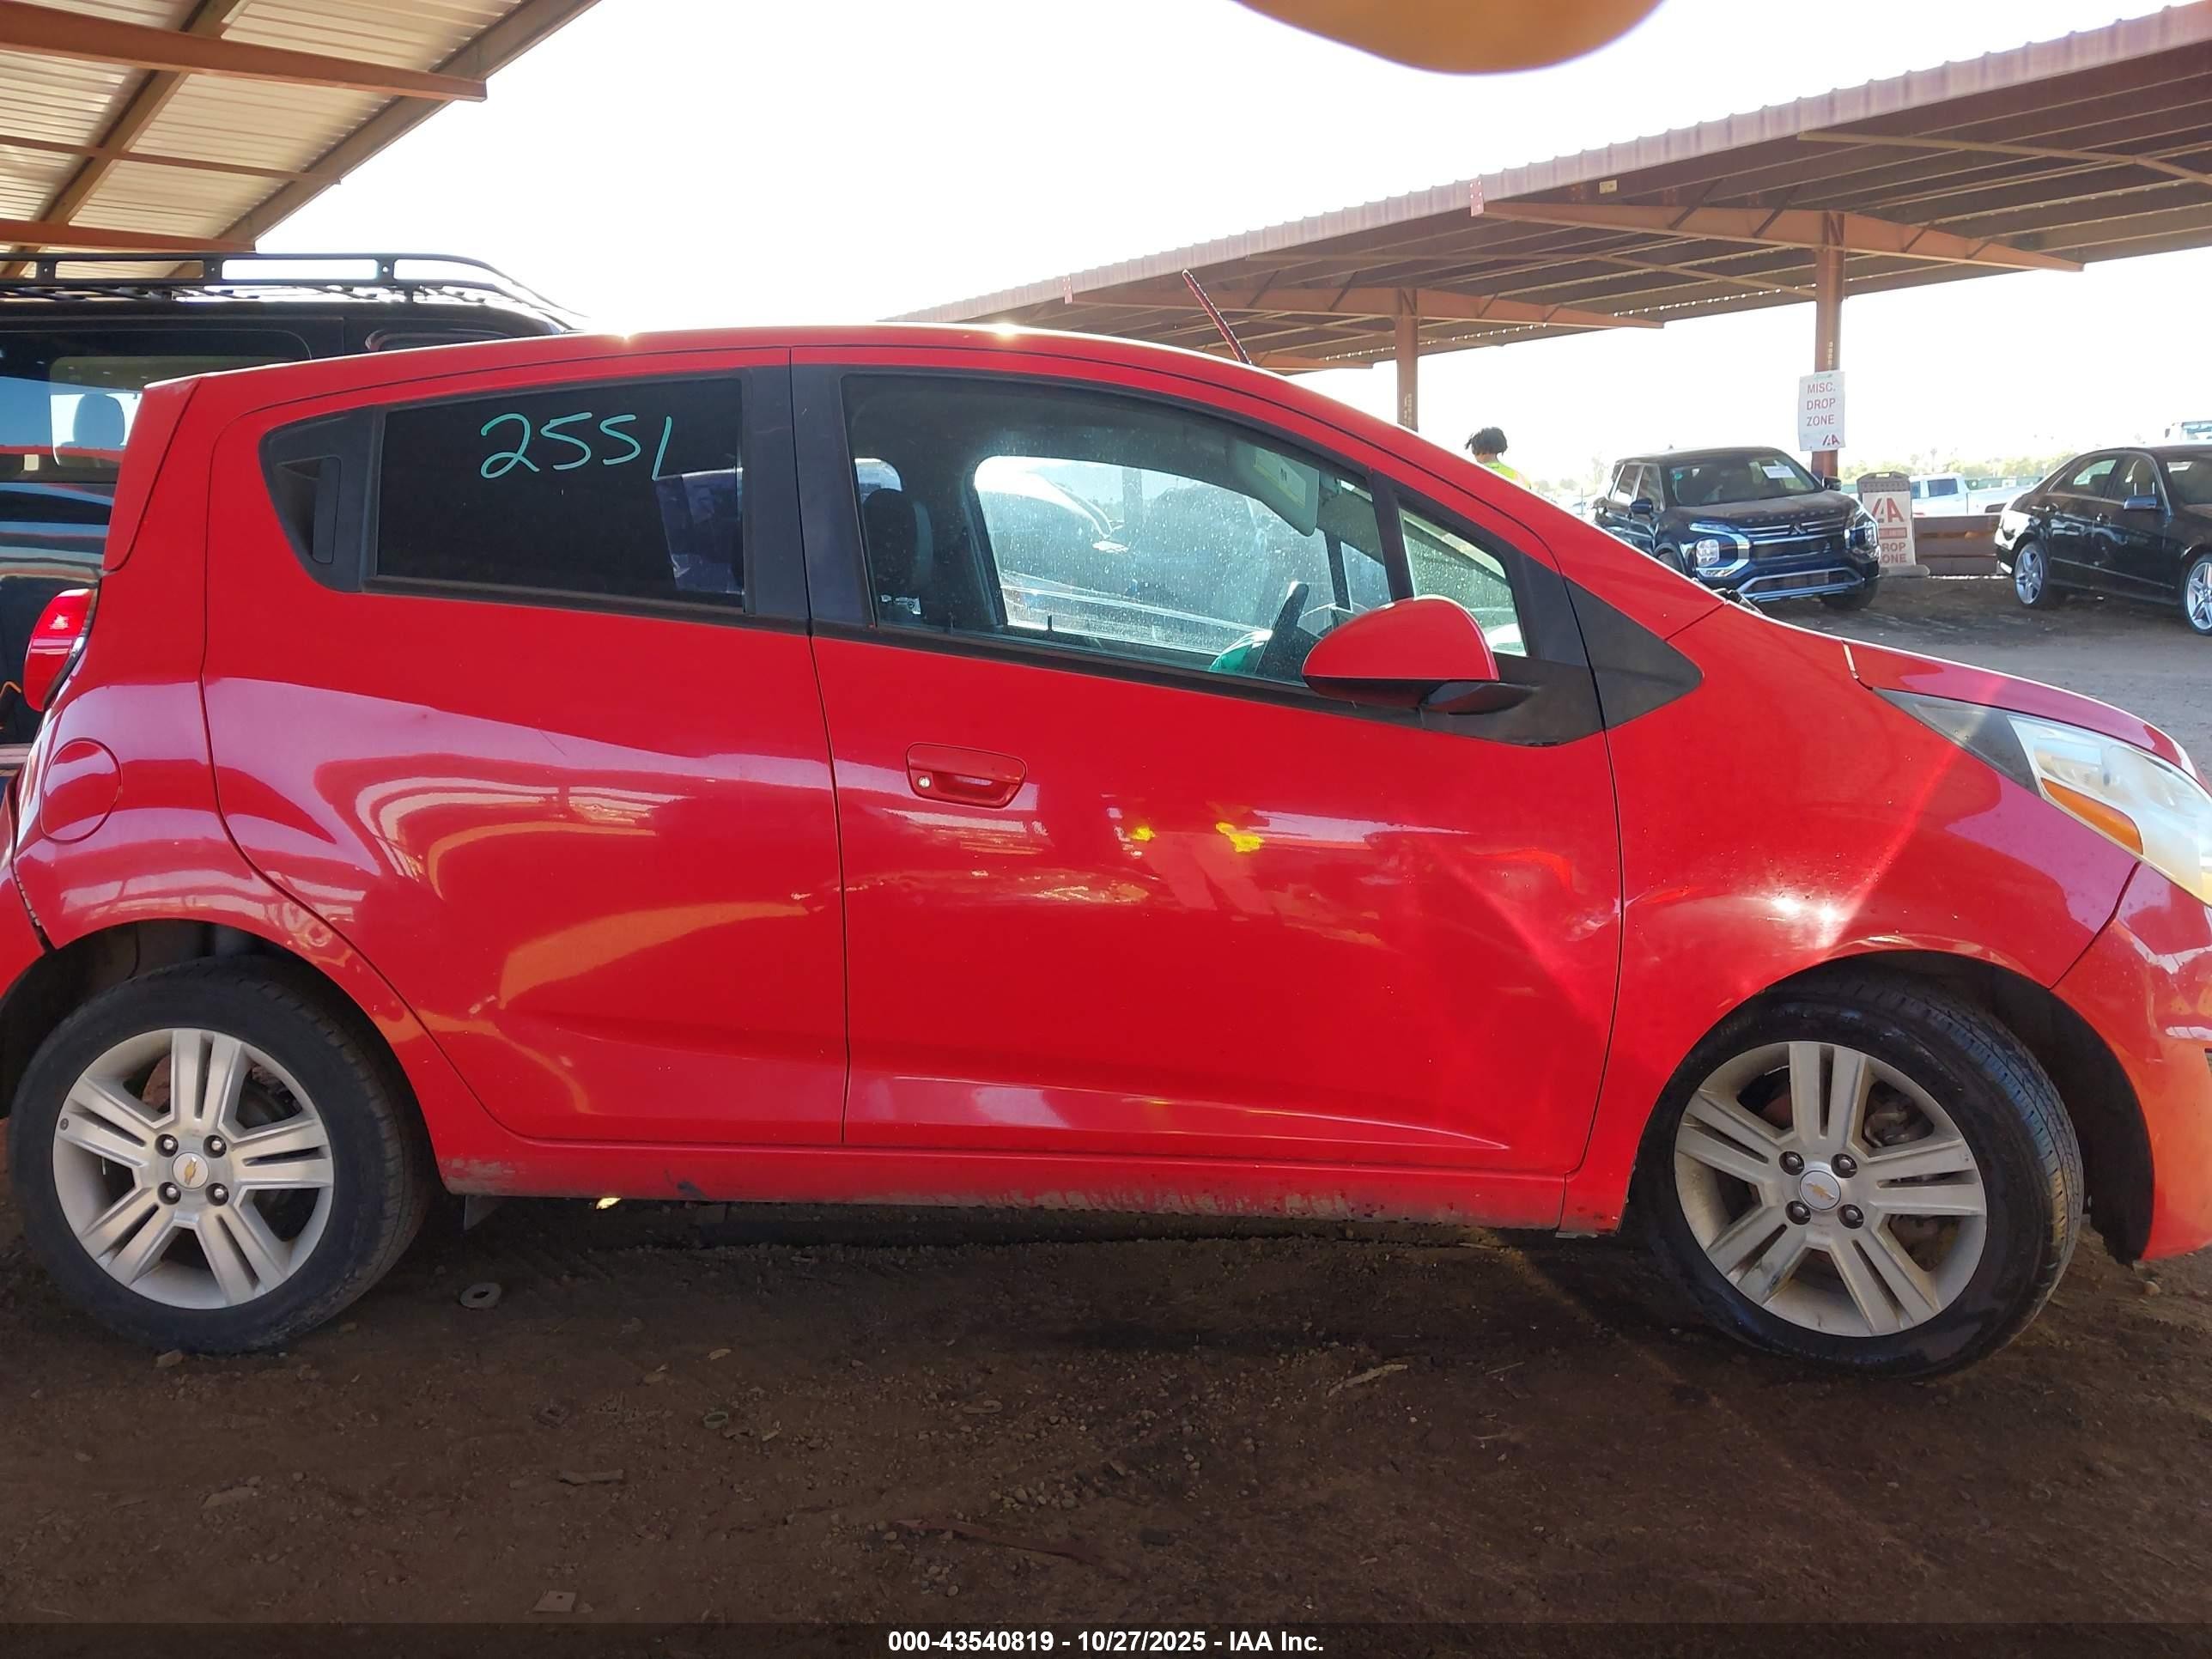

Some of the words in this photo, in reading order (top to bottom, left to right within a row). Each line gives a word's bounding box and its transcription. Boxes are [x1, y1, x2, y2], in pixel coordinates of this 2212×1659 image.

[1807, 381, 1836, 394] MISC.
[1806, 398, 1836, 410] DROP
[1806, 414, 1835, 427] ZONE
[480, 412, 672, 481] 2551
[1881, 542, 1906, 552] ROP
[1880, 553, 1907, 564] ONE
